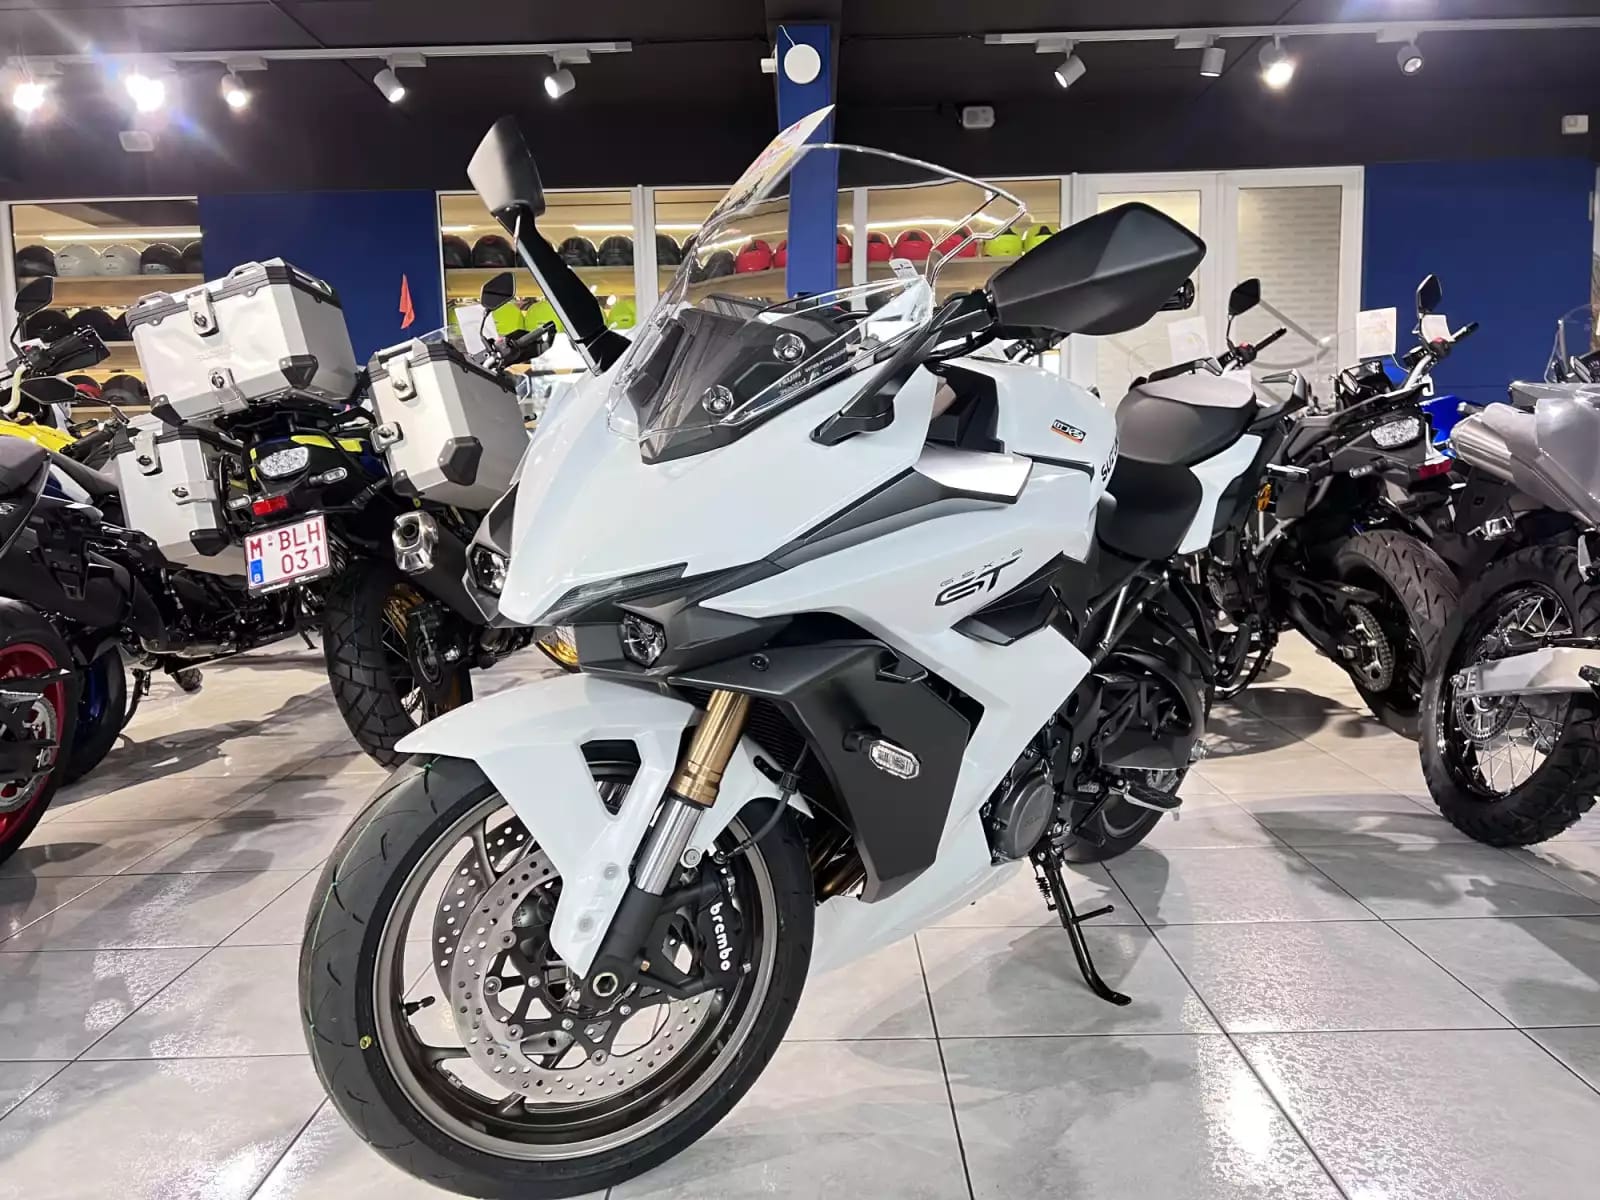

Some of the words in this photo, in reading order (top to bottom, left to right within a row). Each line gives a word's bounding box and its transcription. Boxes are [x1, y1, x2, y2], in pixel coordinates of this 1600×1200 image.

[281, 545, 321, 574] 031
[935, 556, 1020, 606] GT
[710, 902, 733, 971] brembo
